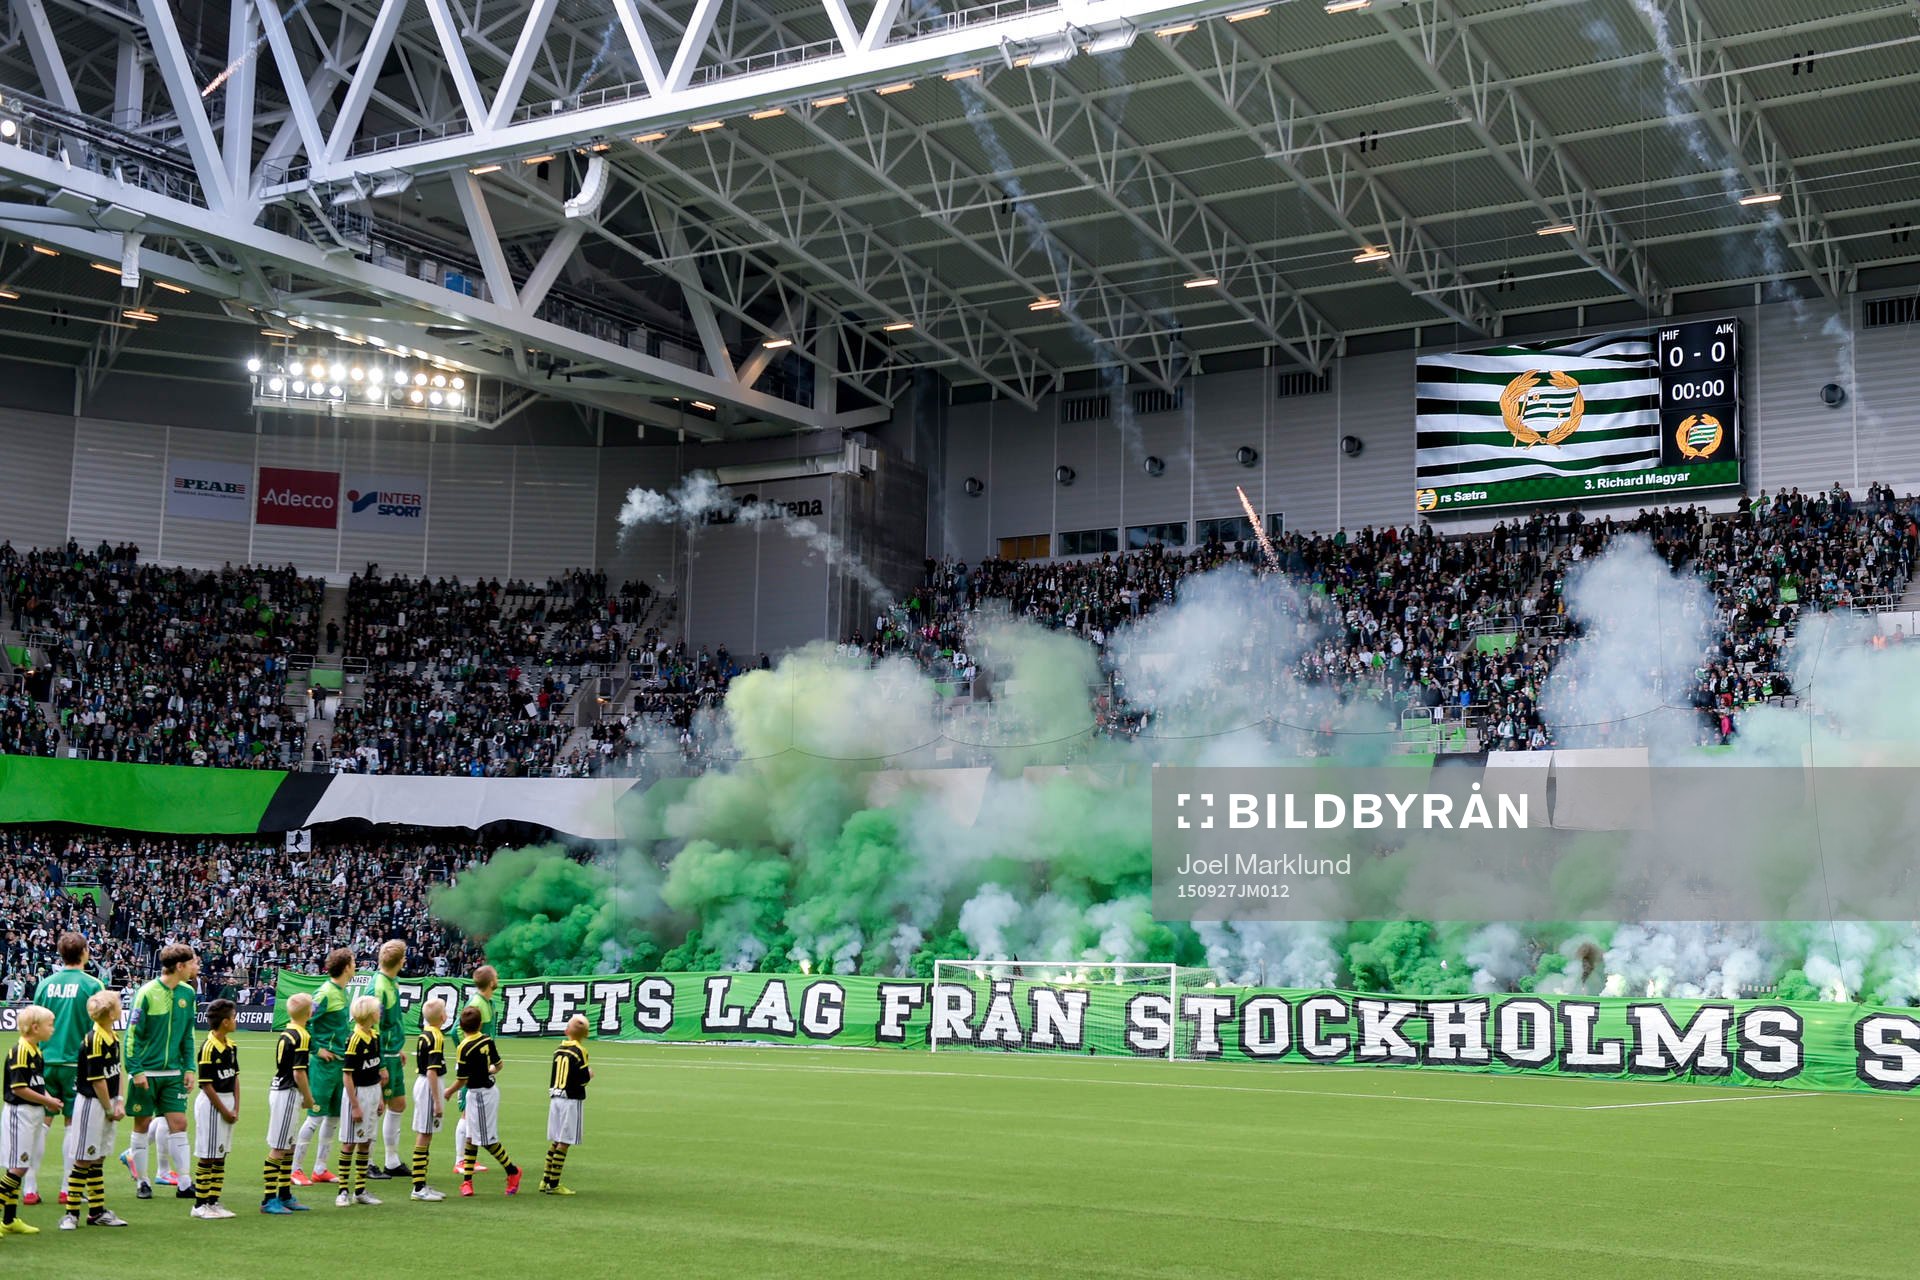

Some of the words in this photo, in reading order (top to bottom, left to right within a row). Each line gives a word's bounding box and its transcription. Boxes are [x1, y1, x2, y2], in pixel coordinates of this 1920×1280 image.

[1661, 329, 1680, 341] HIF
[1715, 322, 1734, 335] AIK
[1669, 346, 1684, 368] 0
[1711, 341, 1726, 363] 0
[1671, 379, 1725, 401] 00:00
[183, 478, 238, 494] PEAB
[1584, 479, 1596, 490] 3.
[1597, 477, 1645, 490] Richard
[1645, 472, 1691, 488] Magyar
[262, 488, 335, 510] Adecco
[379, 491, 422, 505] INTER
[1453, 489, 1488, 502] Sætra
[377, 504, 422, 518] SPORT
[47, 983, 79, 998] BAJEN
[234, 1012, 263, 1023] ASTER
[702, 975, 846, 1039] LAG
[876, 980, 1090, 1050] FRÅN
[1125, 990, 1804, 1081] STOCKHOLMS
[555, 1055, 569, 1090] 10
